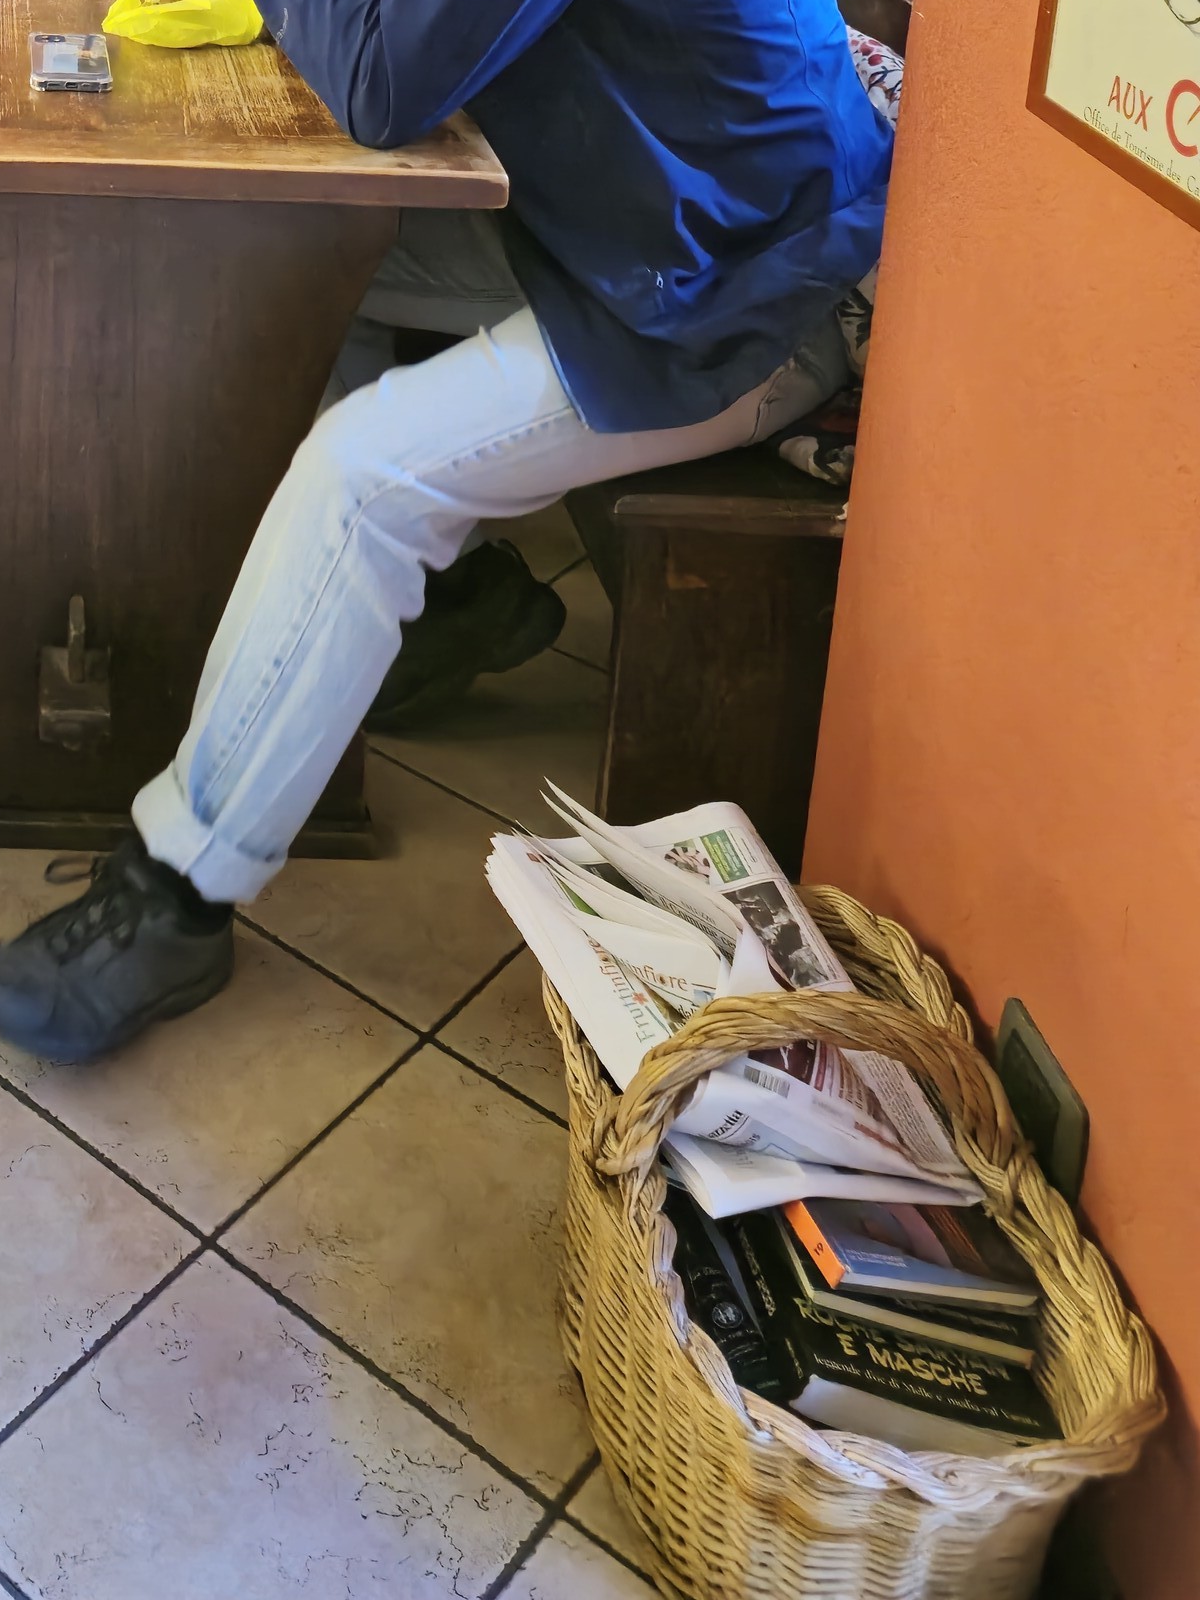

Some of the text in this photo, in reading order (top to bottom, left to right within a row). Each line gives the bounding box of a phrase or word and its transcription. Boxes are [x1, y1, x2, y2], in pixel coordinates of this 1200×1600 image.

[1083, 106, 1111, 135] Office
[1111, 123, 1122, 143] de
[1125, 132, 1165, 172] Tourisme
[1166, 160, 1181, 183] des
[1108, 75, 1200, 158] AUX C
[705, 1107, 744, 1140] azzetta
[836, 1332, 988, 1396] E MASCHE
